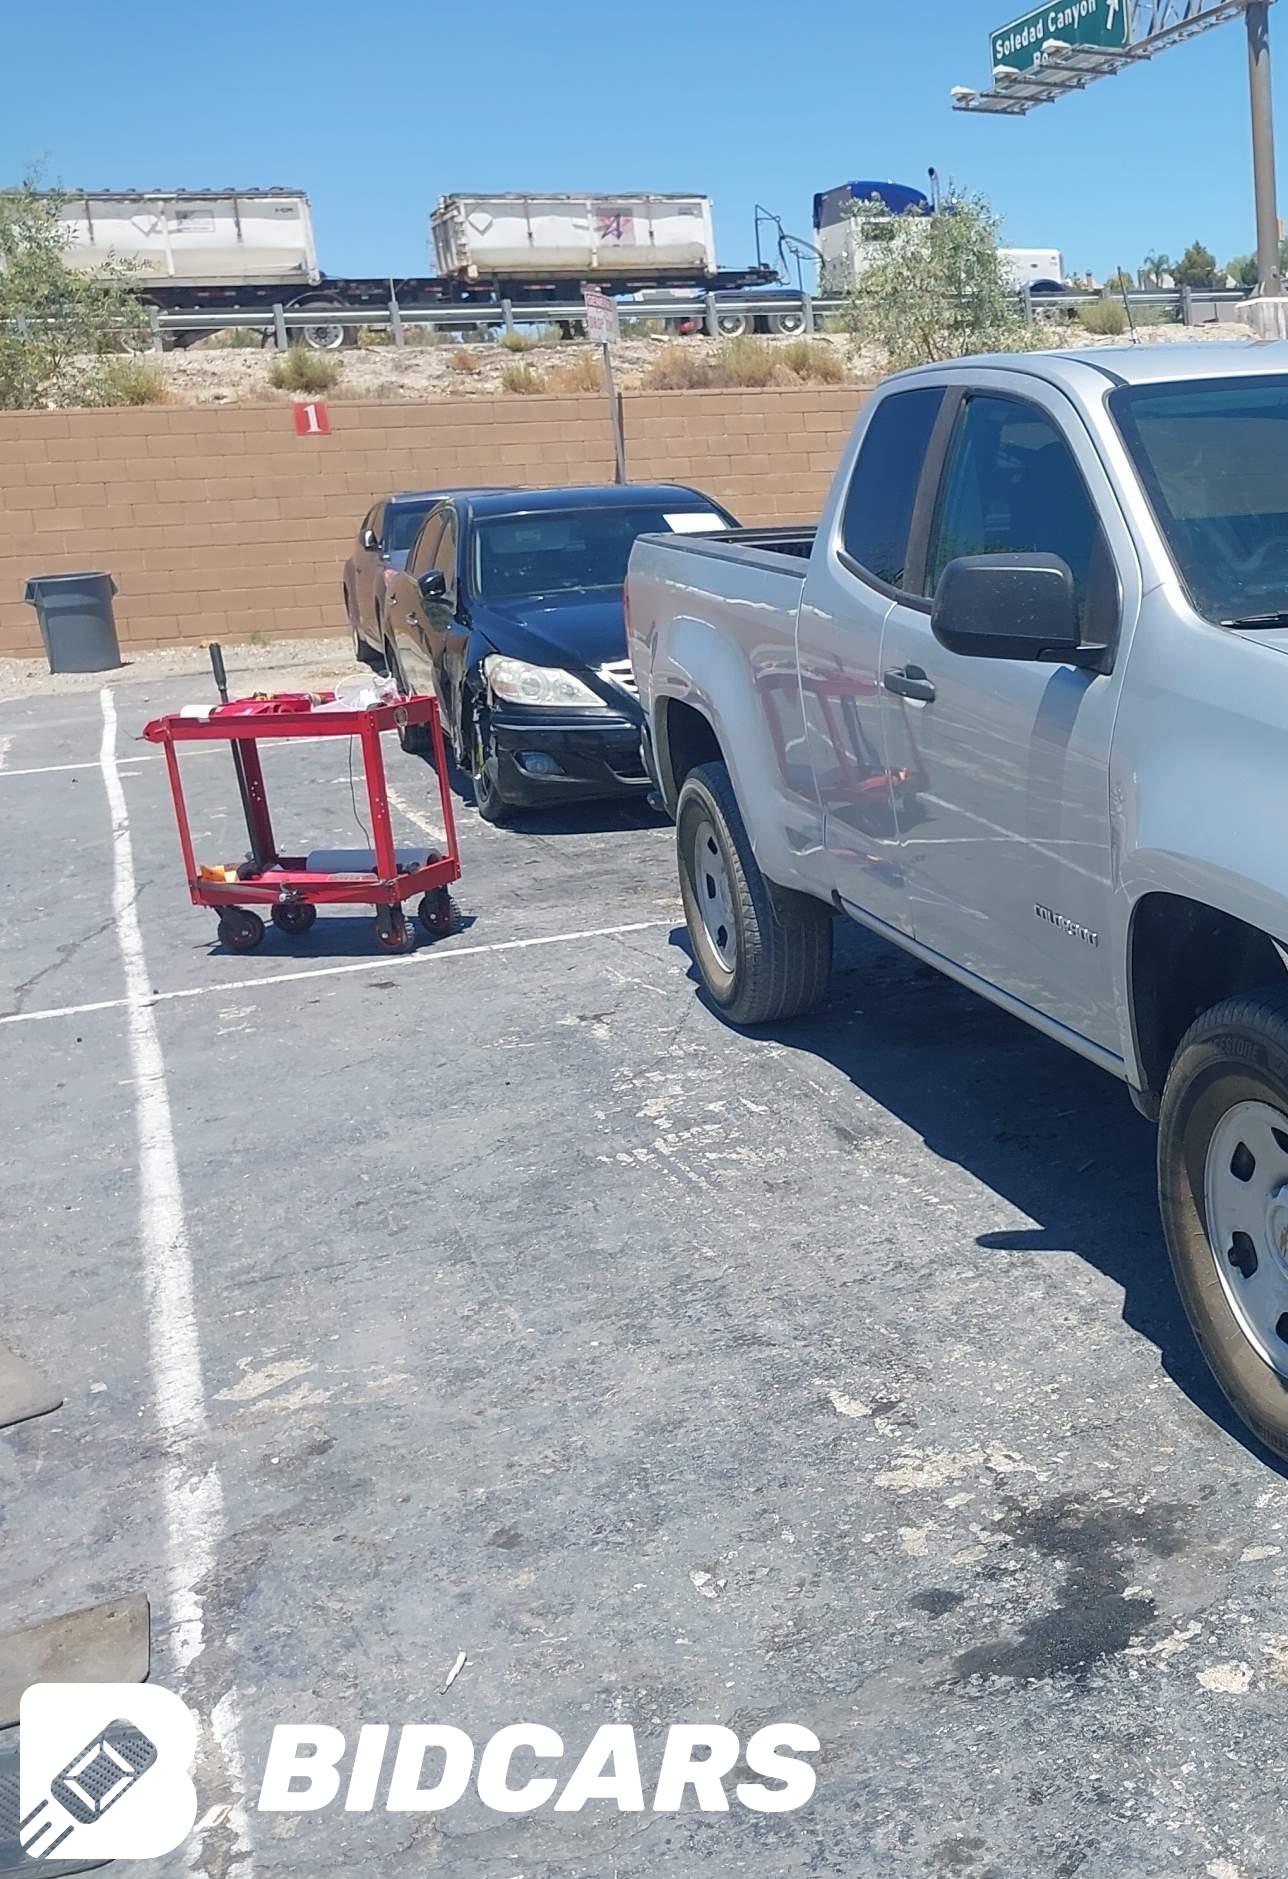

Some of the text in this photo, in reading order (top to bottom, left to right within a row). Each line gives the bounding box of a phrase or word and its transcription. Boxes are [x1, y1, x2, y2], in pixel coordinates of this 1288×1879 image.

[995, 0, 1097, 60] Soledad Canyon
[303, 404, 323, 433] 1
